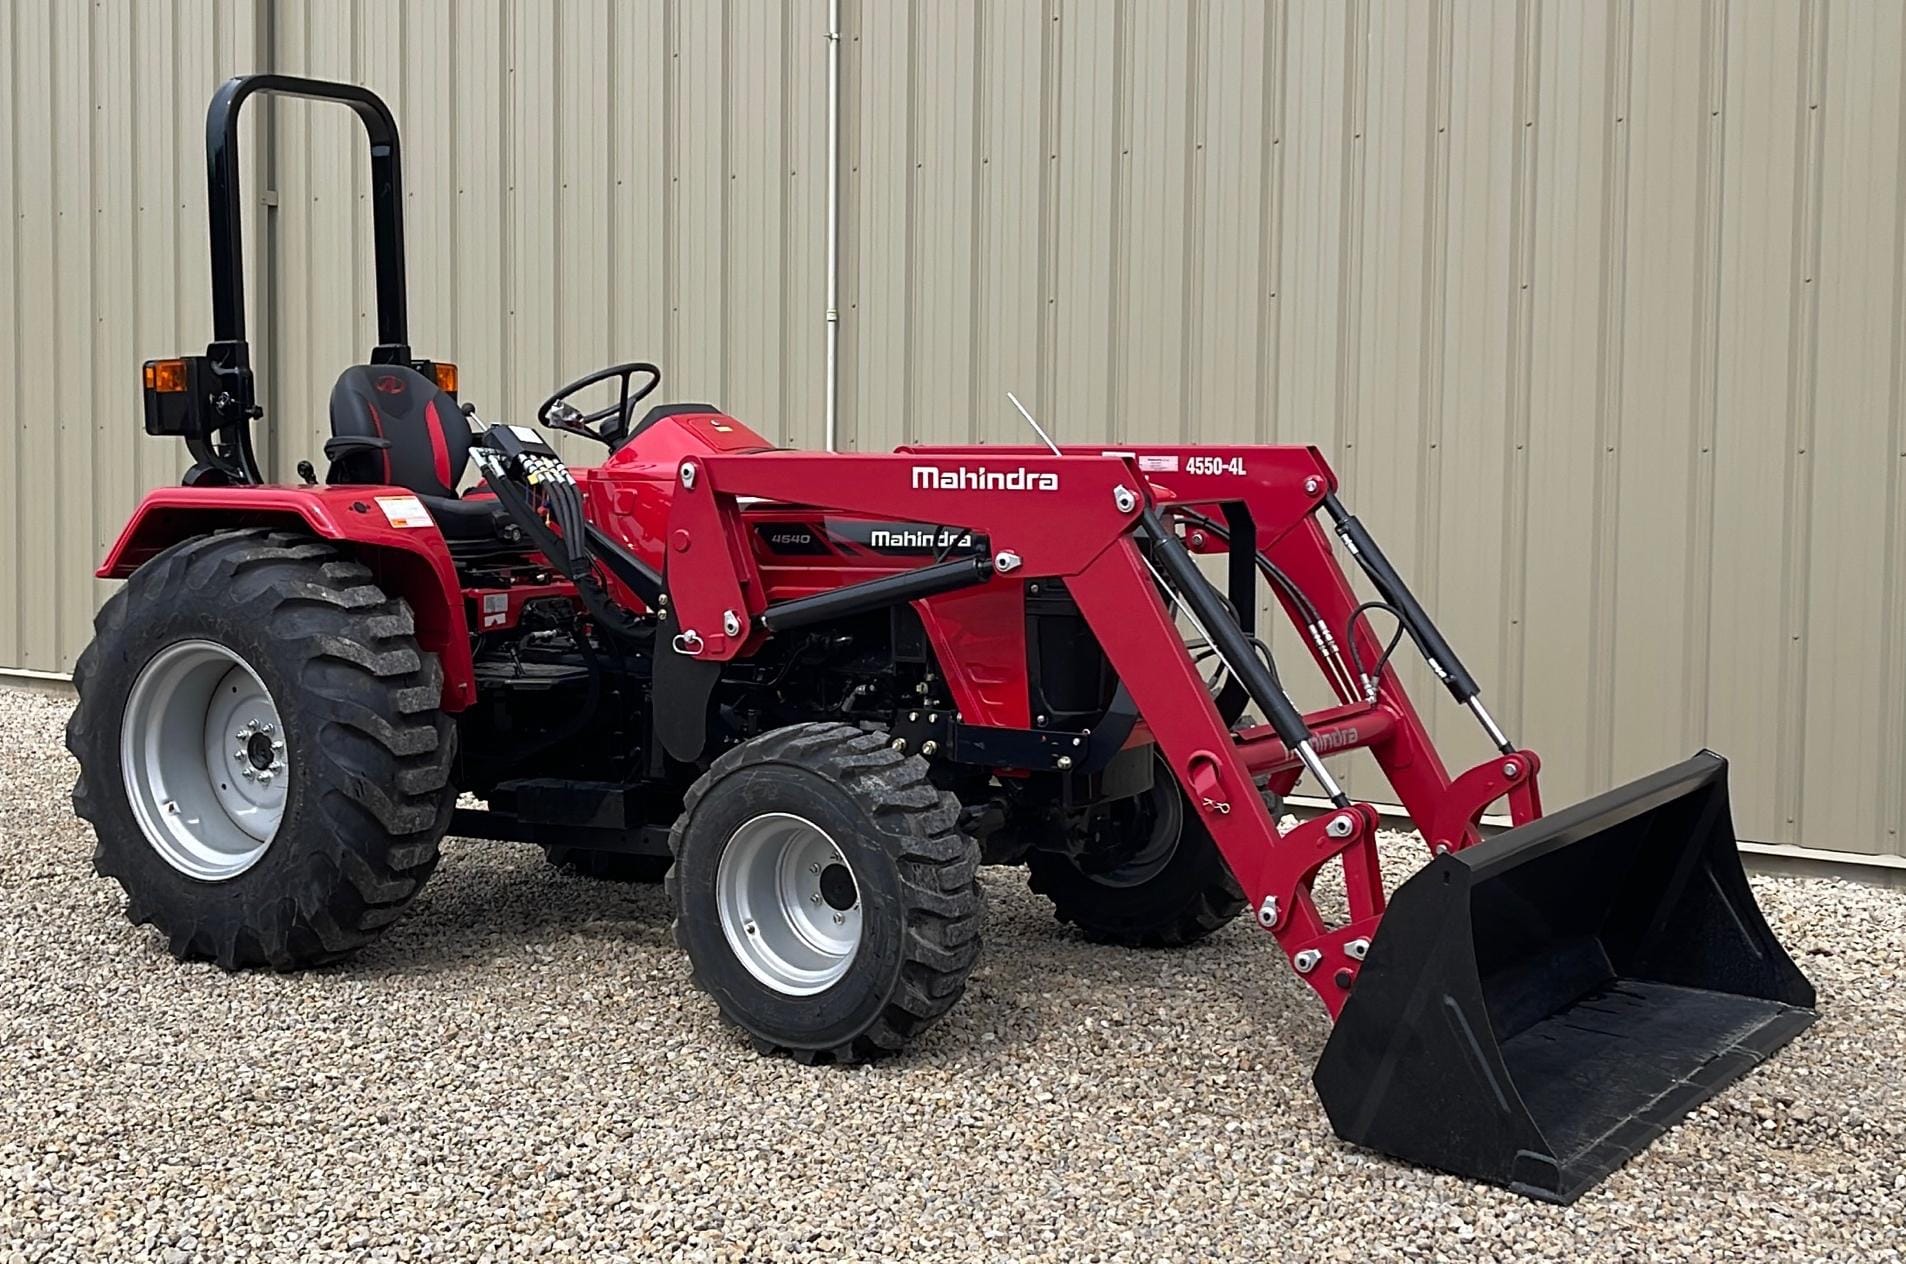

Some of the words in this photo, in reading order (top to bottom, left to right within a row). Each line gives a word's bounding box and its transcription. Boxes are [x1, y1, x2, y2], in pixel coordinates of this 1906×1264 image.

[1186, 457, 1247, 475] 4550-4L
[911, 466, 1059, 491] Mahindra
[871, 530, 972, 547] Mahindra
